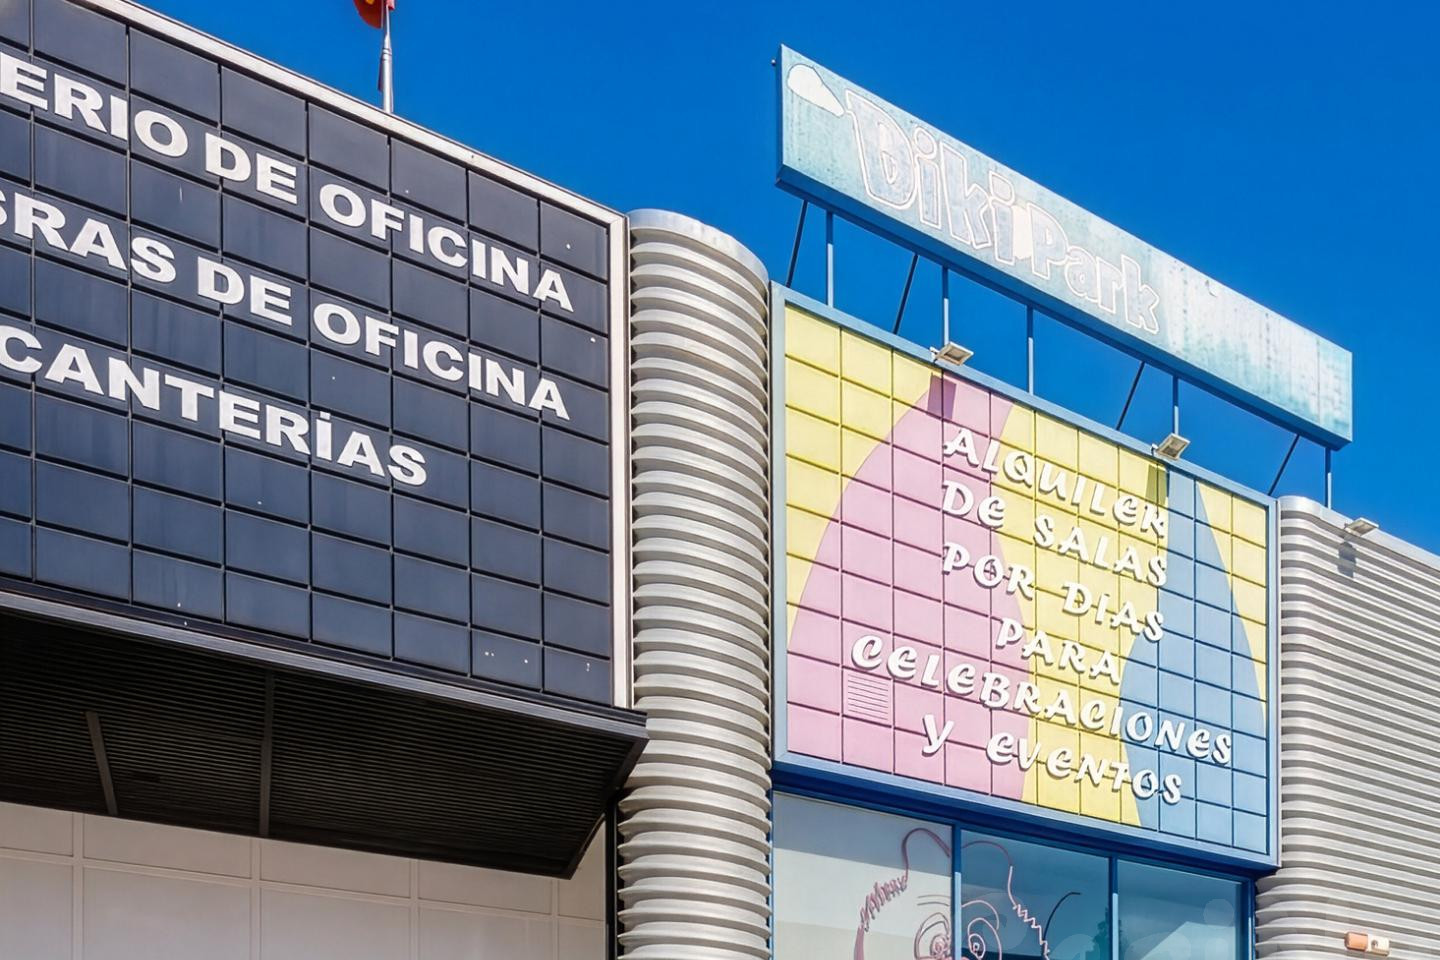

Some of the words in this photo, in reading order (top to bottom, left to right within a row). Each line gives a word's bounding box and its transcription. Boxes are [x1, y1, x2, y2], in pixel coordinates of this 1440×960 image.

[0, 50, 189, 158] ERIO
[204, 131, 298, 205] DE
[318, 182, 574, 313] OFICINA
[1026, 202, 1160, 335] Park
[196, 255, 293, 326] DE
[312, 302, 571, 421] OFICINA
[942, 542, 1034, 601] POR
[1033, 515, 1168, 588] SALAS
[995, 616, 1123, 686] PARA
